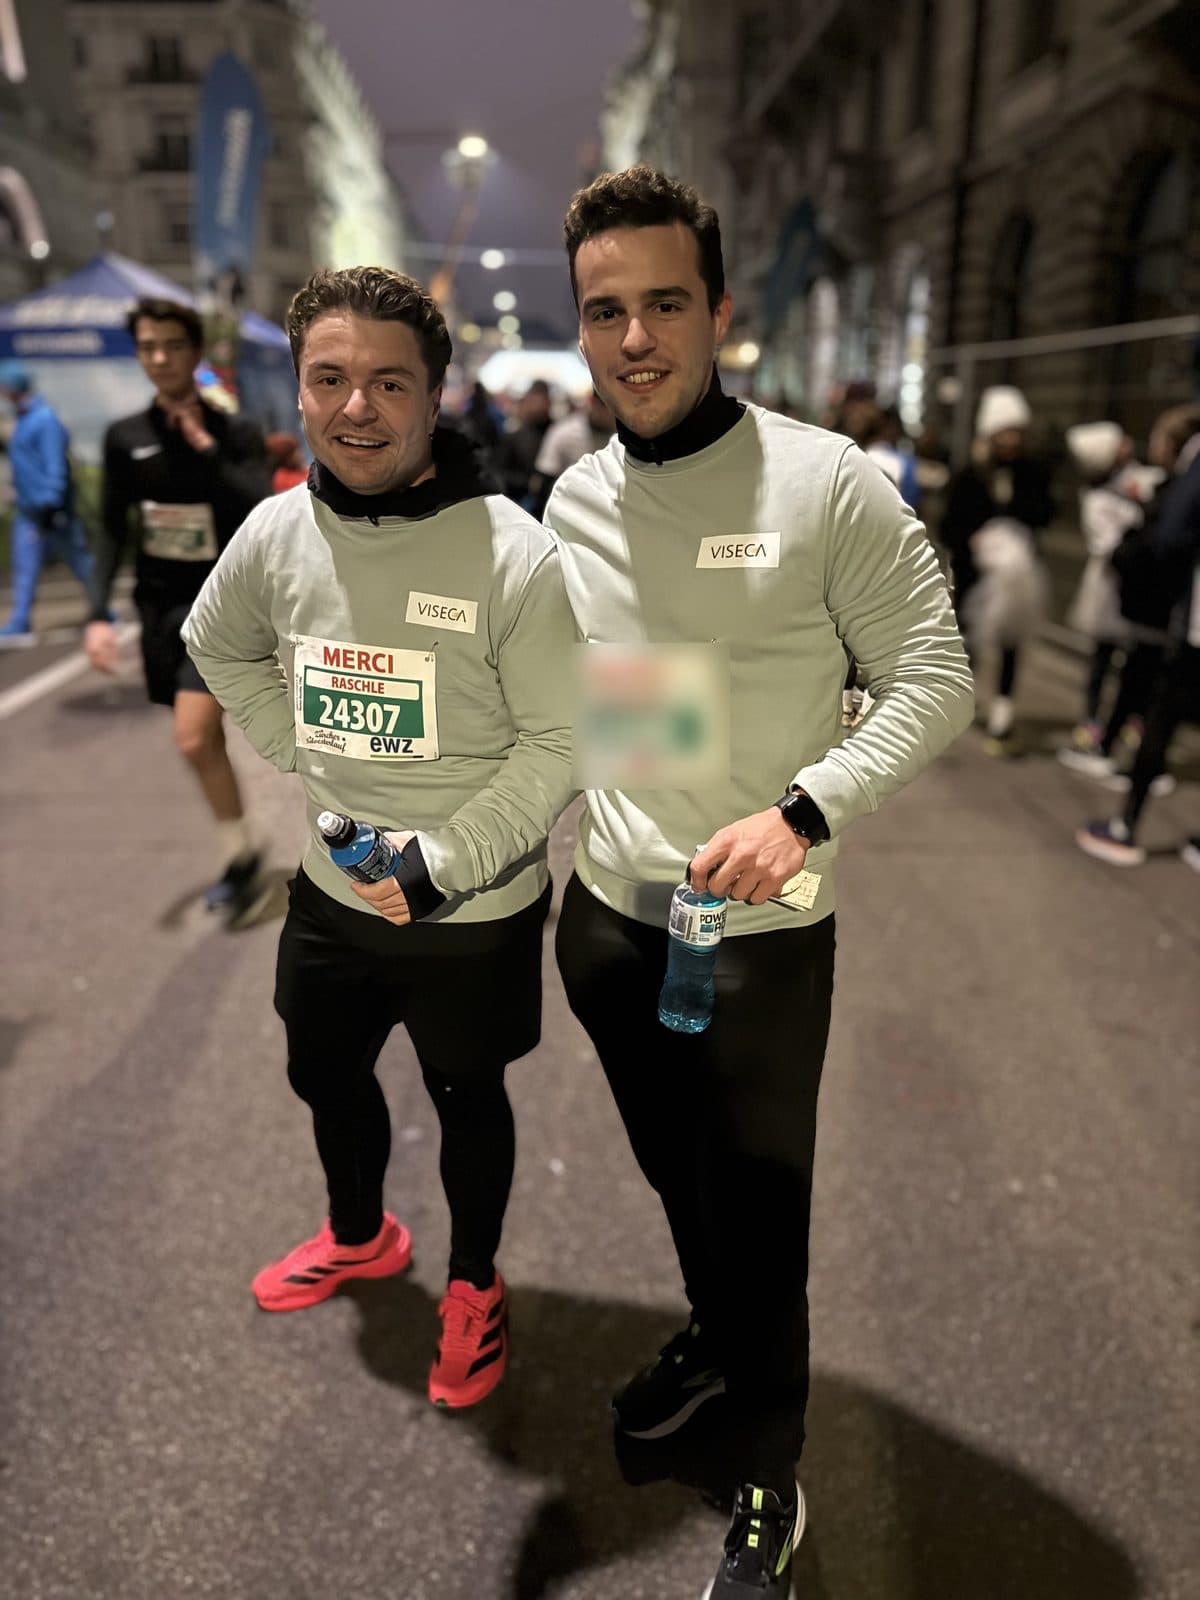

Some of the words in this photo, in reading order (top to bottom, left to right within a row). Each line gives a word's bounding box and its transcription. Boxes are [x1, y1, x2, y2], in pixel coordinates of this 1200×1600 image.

[711, 543, 767, 559] VISECA
[418, 602, 467, 623] VISECA
[323, 646, 394, 674] MERCI
[331, 676, 385, 694] RASCHLE
[319, 694, 400, 734] 24307
[370, 736, 414, 753] ewz
